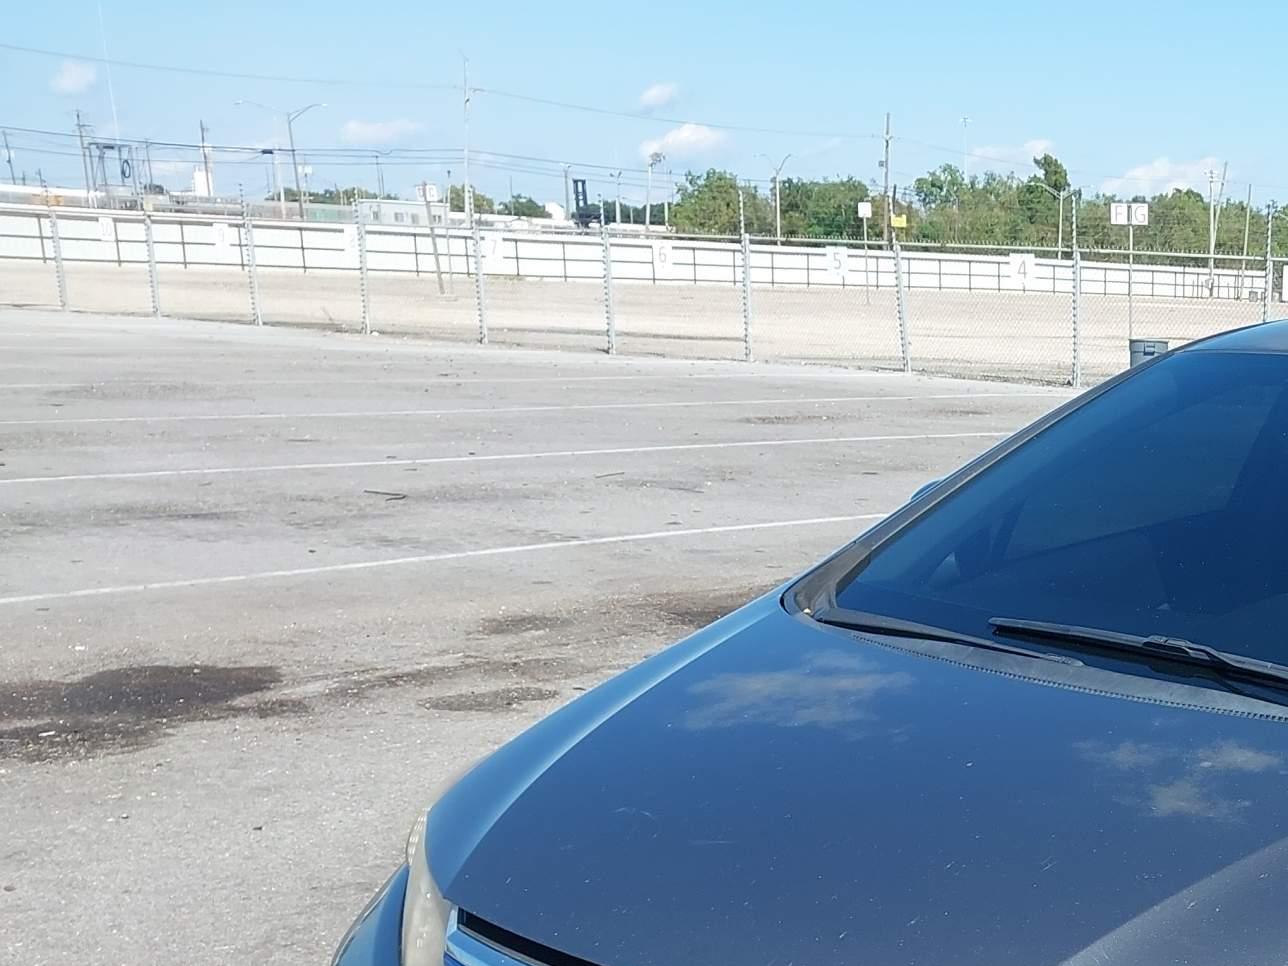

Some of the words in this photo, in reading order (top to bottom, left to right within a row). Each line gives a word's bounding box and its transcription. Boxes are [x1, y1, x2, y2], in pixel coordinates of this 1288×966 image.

[1114, 204, 1123, 224] F
[1134, 204, 1146, 224] G
[658, 248, 668, 264] 6
[833, 252, 843, 270] 5
[1017, 259, 1028, 279] 4
